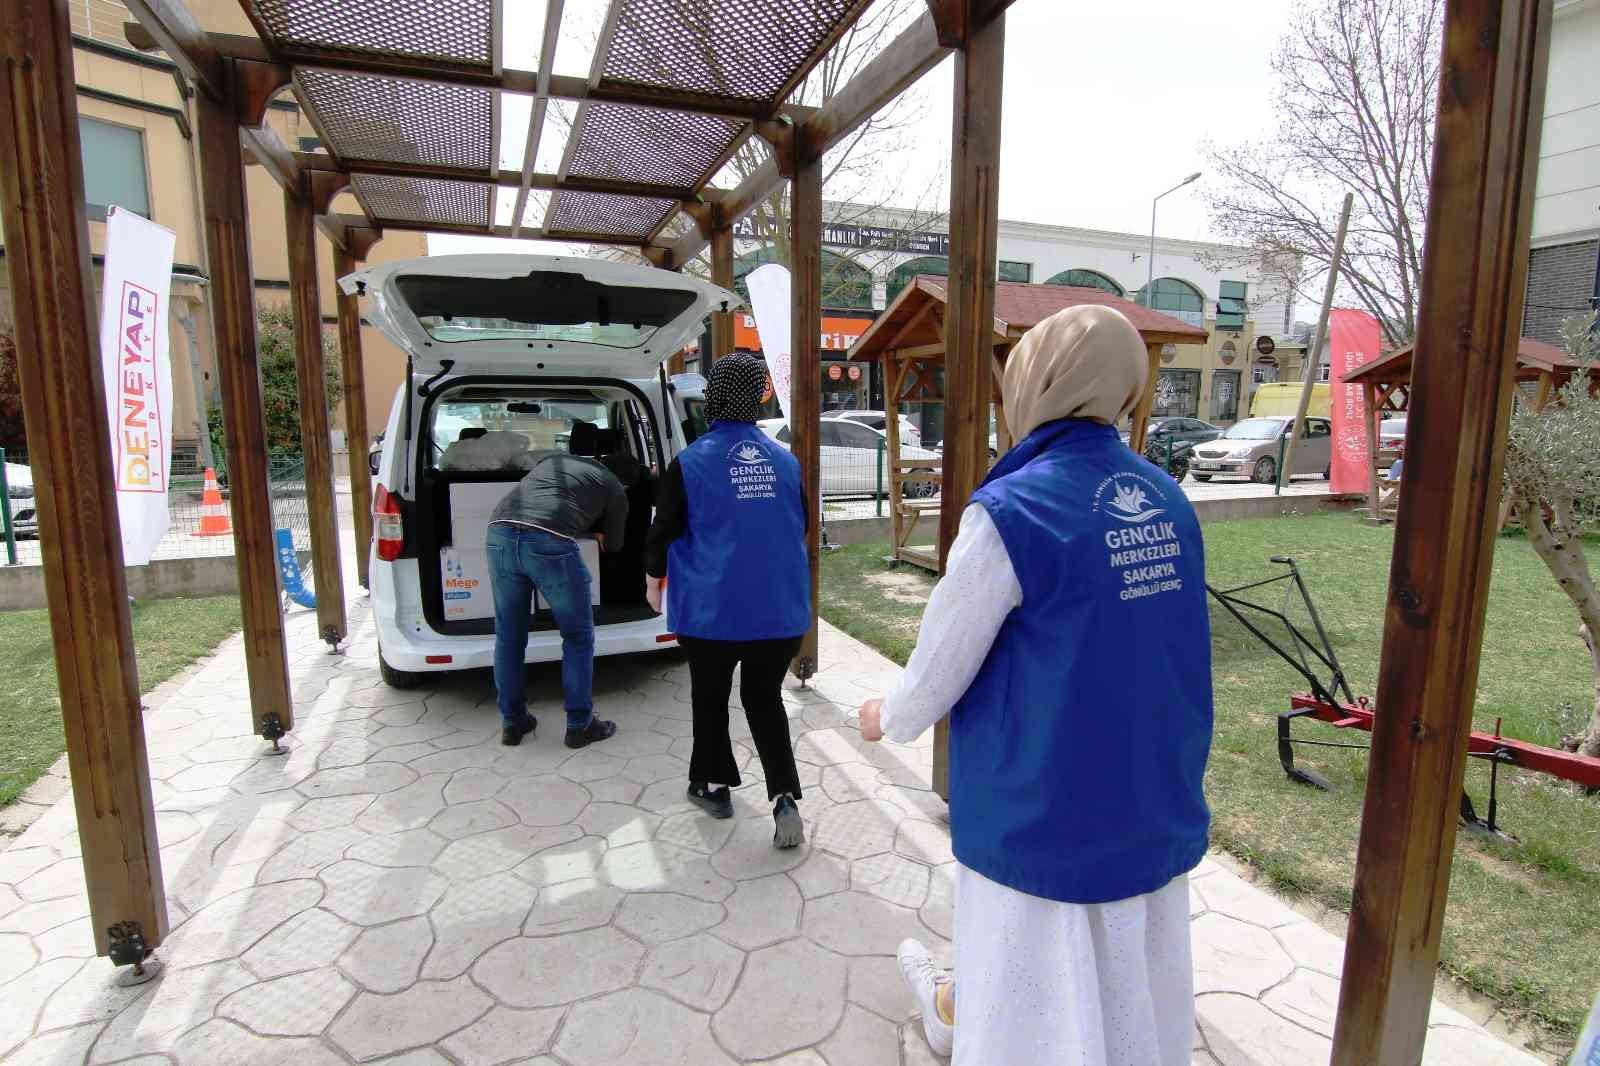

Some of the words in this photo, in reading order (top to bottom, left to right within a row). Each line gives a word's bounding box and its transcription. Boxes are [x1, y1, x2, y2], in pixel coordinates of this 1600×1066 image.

[124, 290, 150, 485] DENEYAP
[1105, 521, 1178, 549] GENÇLİK
[1110, 541, 1181, 568] MERKEZLERİ
[1123, 562, 1176, 585] SAKARYA
